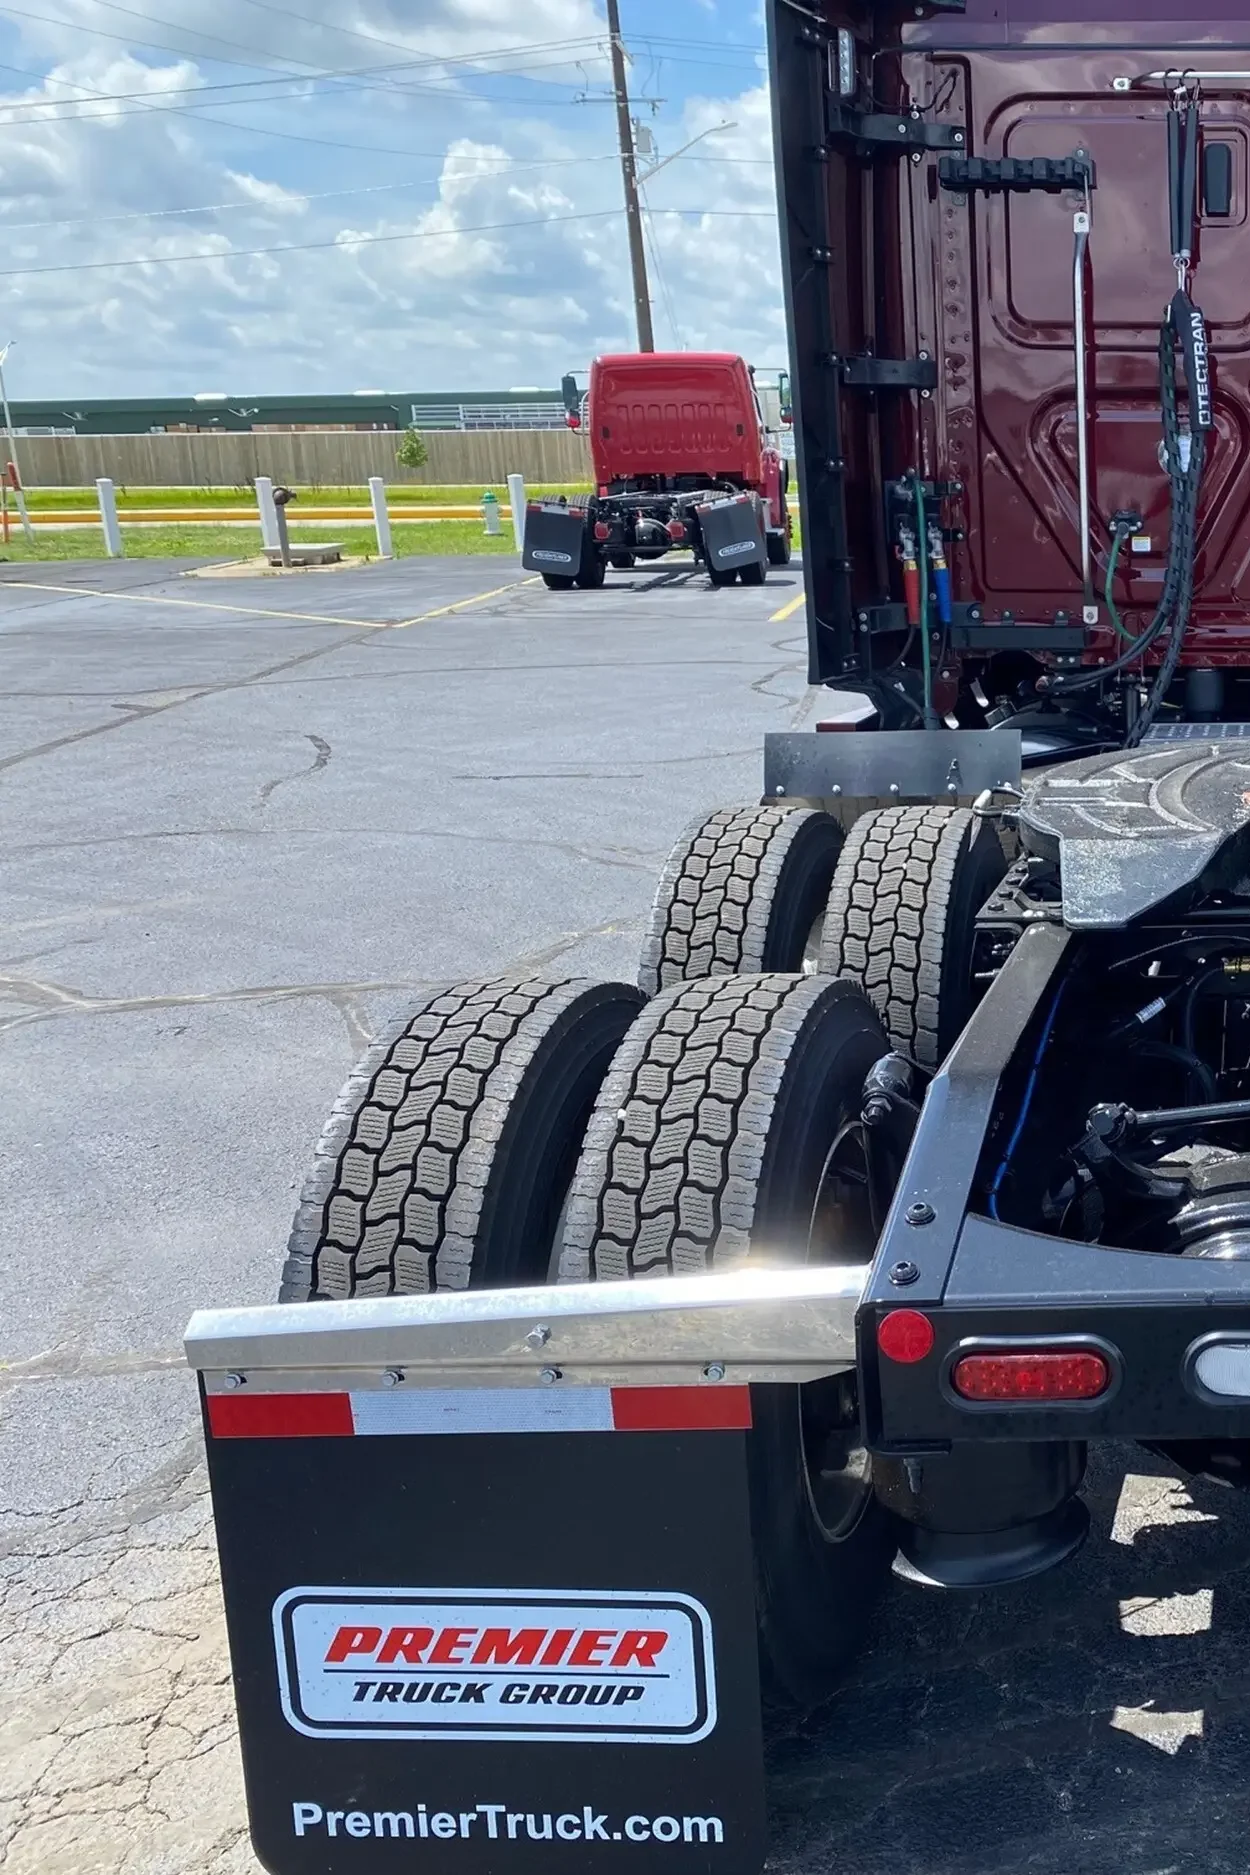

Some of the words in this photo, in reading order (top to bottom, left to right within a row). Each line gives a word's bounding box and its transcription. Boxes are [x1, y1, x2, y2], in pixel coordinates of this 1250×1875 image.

[324, 1626, 669, 1667] PREMIER
[352, 1681, 495, 1704] TRUCK
[498, 1683, 646, 1706] GROUP
[291, 1802, 725, 1843] PremierTruck.com
